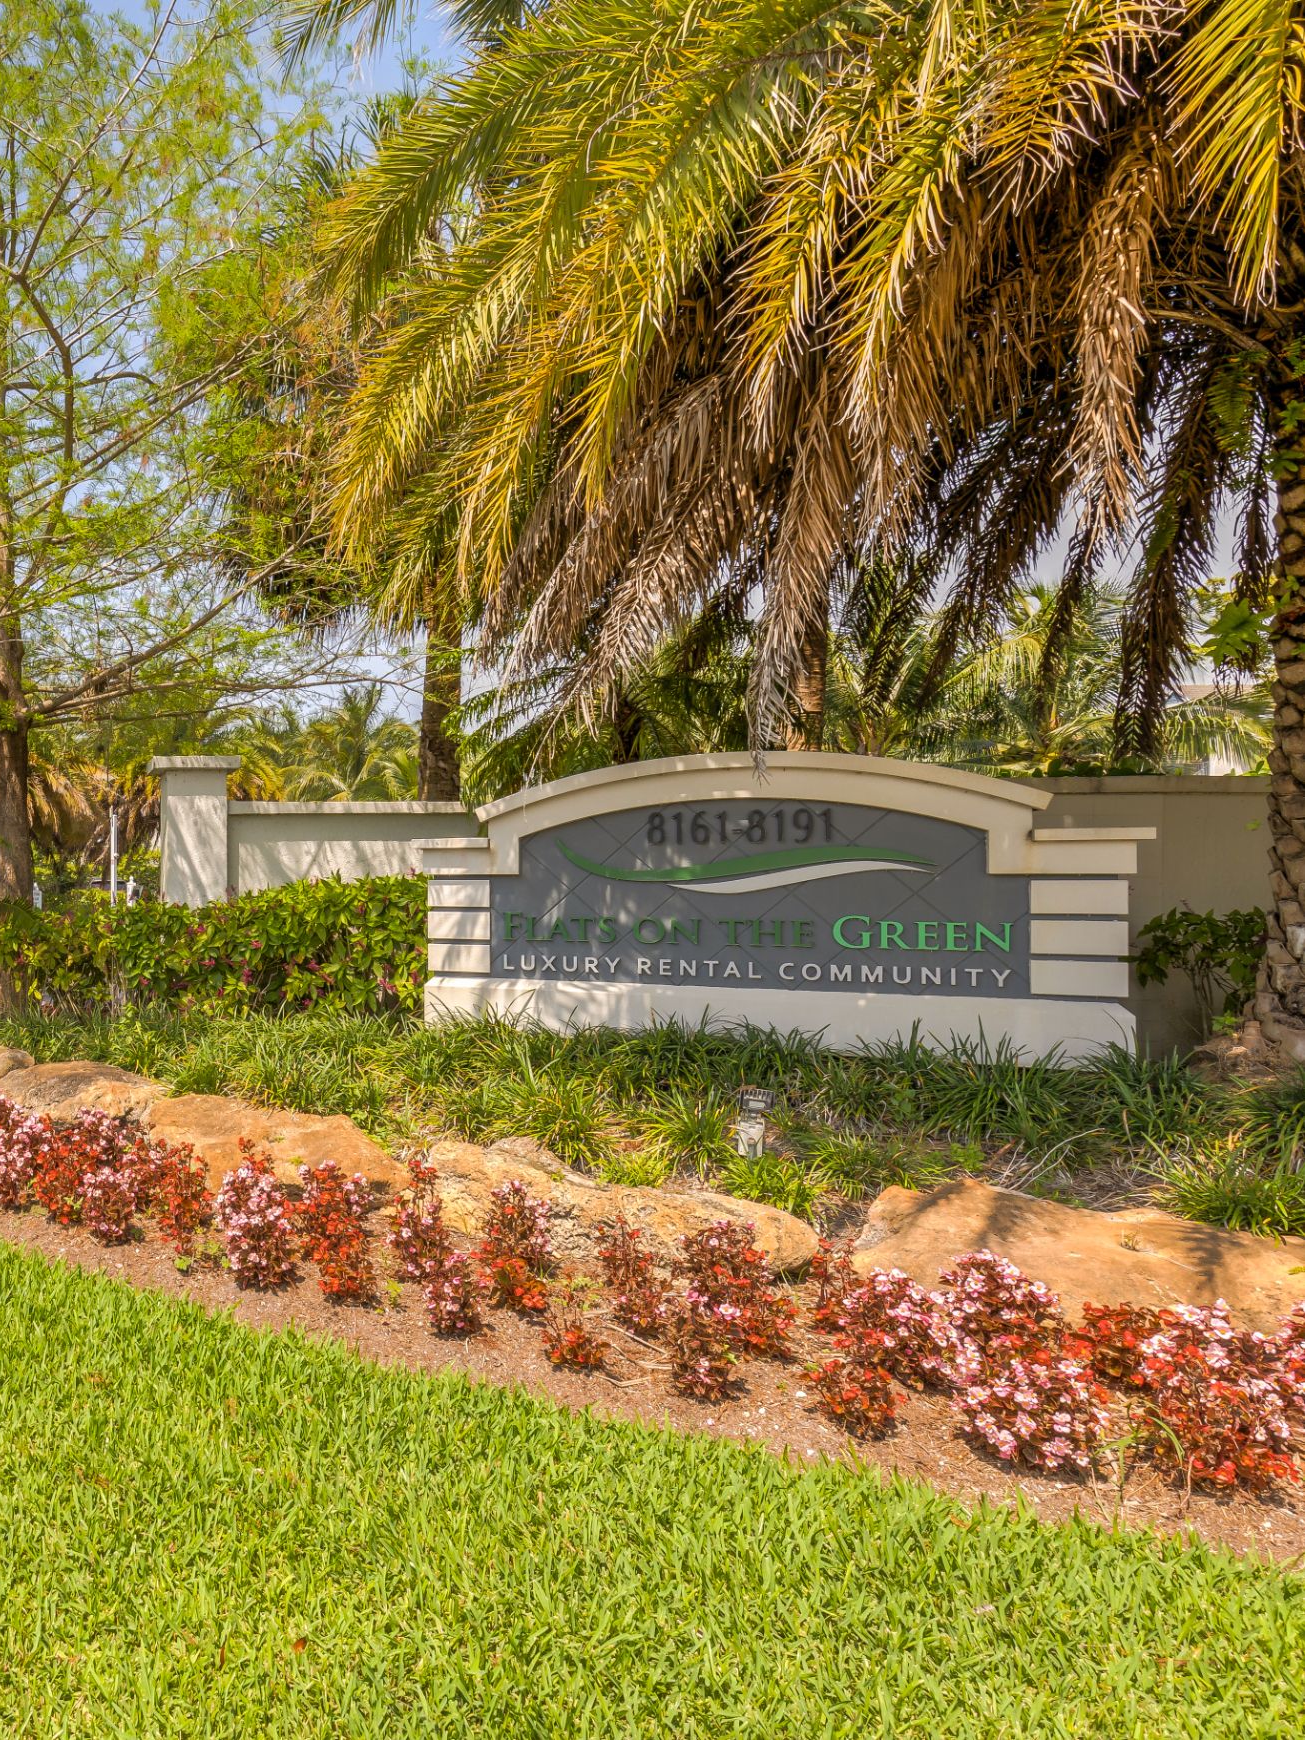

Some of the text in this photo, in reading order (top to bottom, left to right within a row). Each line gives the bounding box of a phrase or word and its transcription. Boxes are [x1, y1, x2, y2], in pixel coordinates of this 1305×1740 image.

[646, 807, 833, 846] 8161-8191
[502, 911, 1014, 953] FLATS ON THE GREEN
[502, 953, 1013, 988] LUXURY RENTAL COMMUNITY
